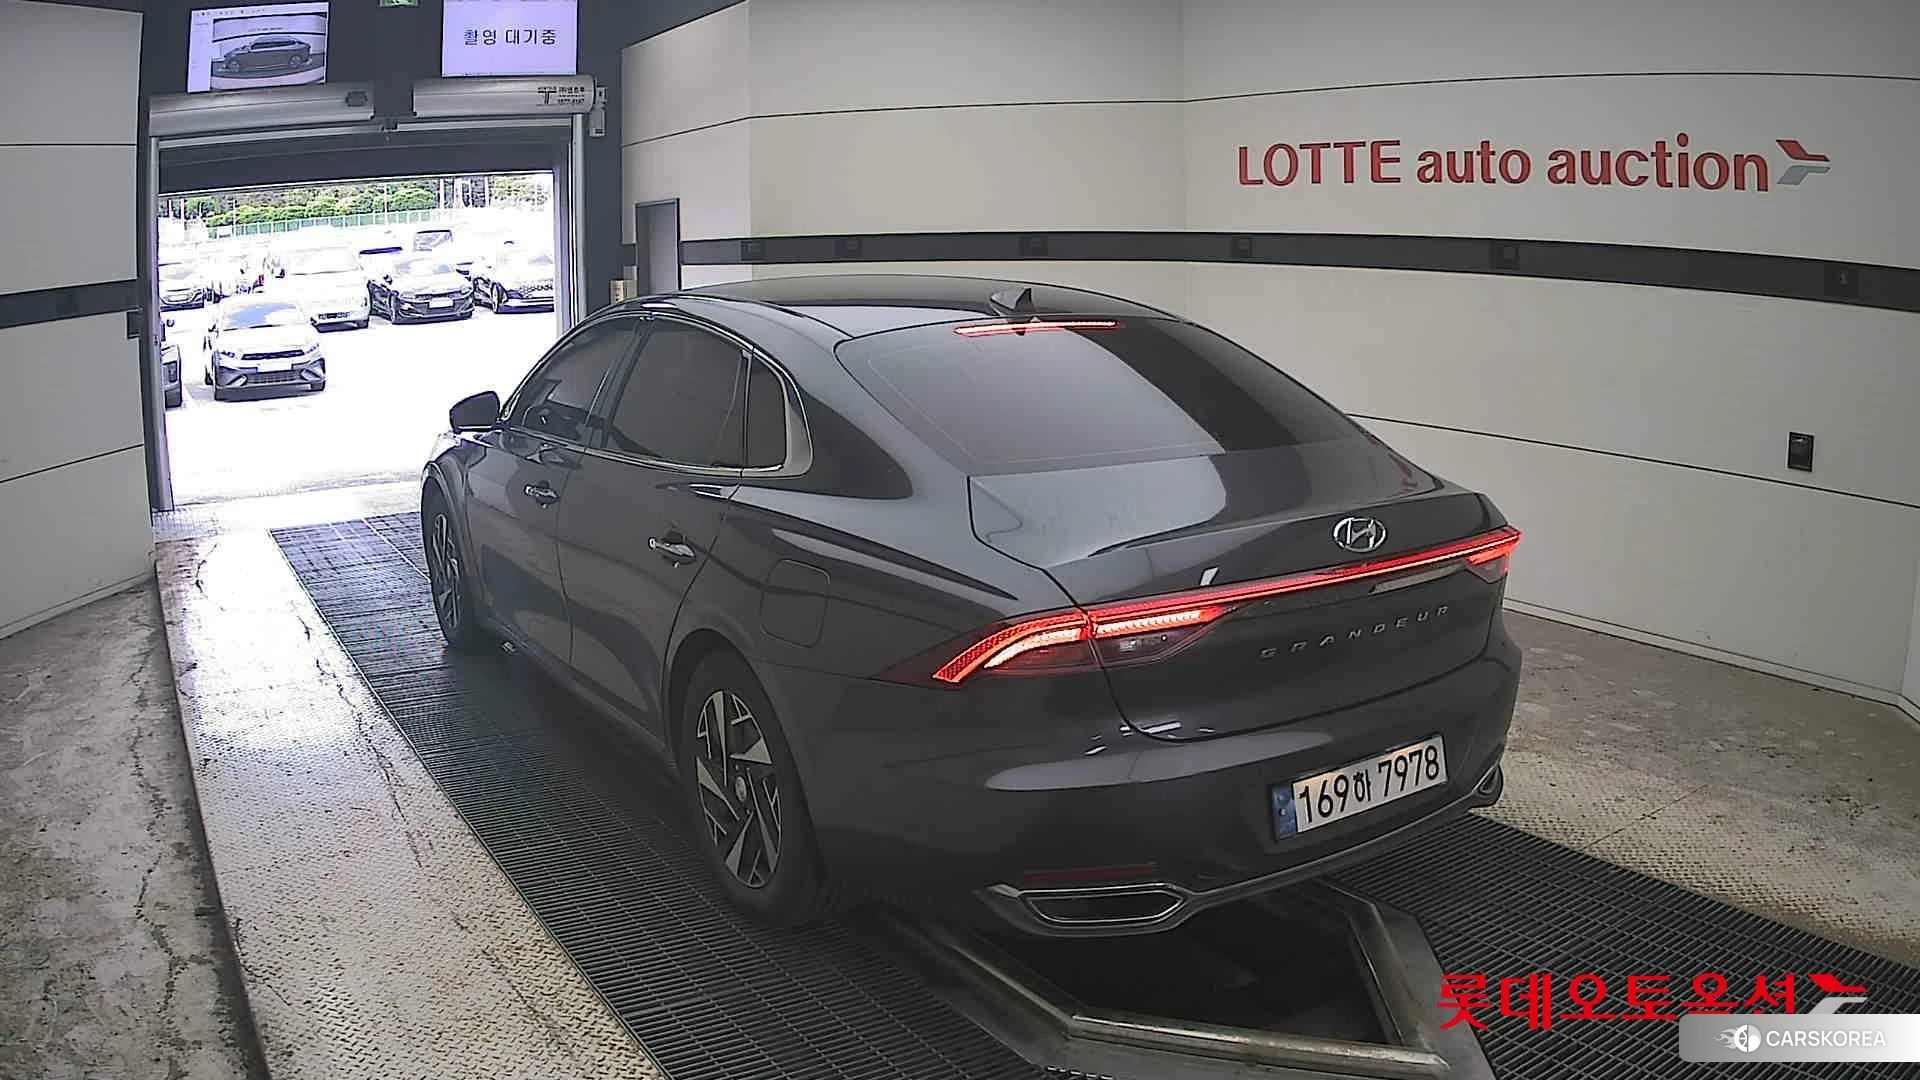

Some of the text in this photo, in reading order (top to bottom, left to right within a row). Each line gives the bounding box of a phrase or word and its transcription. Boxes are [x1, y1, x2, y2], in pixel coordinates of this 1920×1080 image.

[463, 29, 557, 46] 촬영 대기중
[1238, 132, 1769, 191] LOTTE auto auction
[1260, 605, 1449, 658] GRANDEUR
[1299, 745, 1440, 823] 169하 7978
